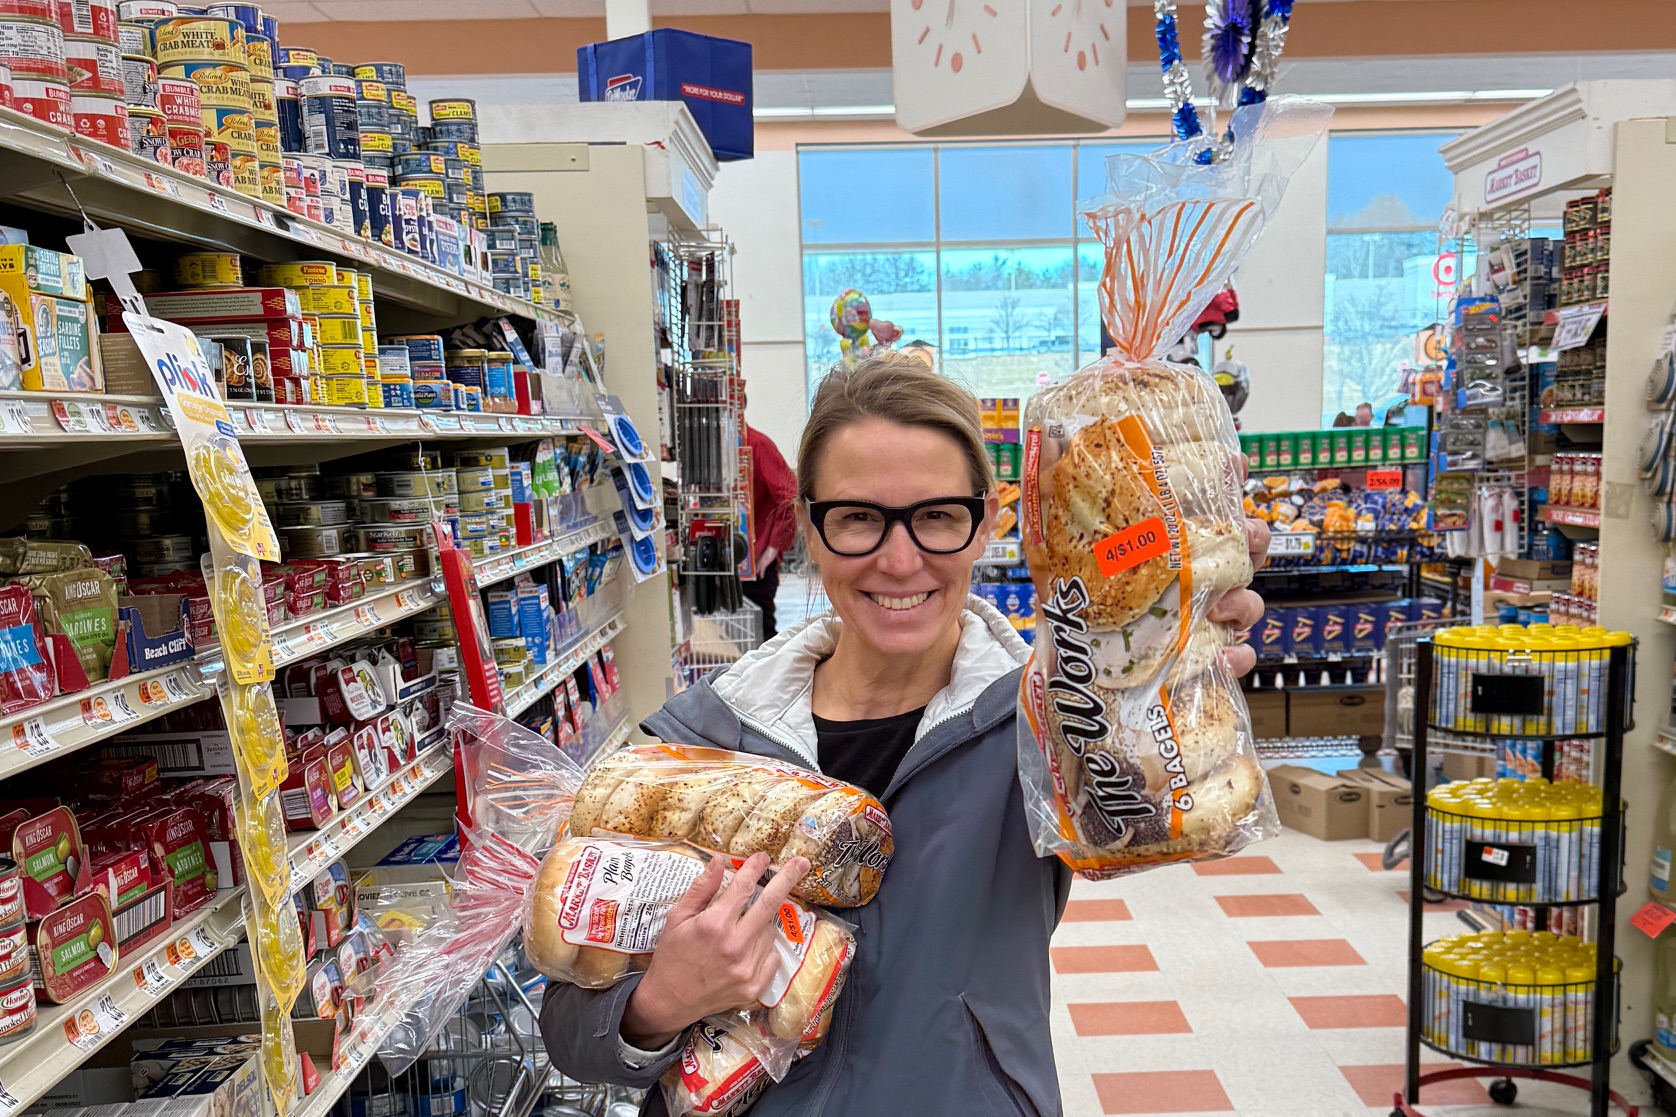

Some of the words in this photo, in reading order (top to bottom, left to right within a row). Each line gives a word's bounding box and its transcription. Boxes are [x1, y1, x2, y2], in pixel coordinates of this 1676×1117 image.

[160, 40, 180, 51] CRAB
[181, 39, 213, 51] MEAT
[181, 31, 216, 40] WHITE
[197, 71, 223, 81] Roland
[165, 85, 191, 94] BUMBLE
[200, 85, 228, 95] CRAB
[177, 134, 204, 146] GEISH
[57, 320, 82, 336] SARDINE
[58, 334, 81, 351] FILLETS
[157, 352, 218, 401] plink
[1160, 490, 1172, 501] LB
[1168, 524, 1179, 535] 20
[1105, 530, 1156, 562] 4/$1.00
[1168, 552, 1182, 570] NET
[65, 583, 77, 601] KING
[76, 580, 101, 597] OSCAR
[0, 597, 19, 615] SCAR
[145, 642, 169, 660] Beach
[169, 635, 188, 654] Cliff
[1041, 575, 1113, 757] Works
[1147, 704, 1189, 792] BAGELS
[1084, 750, 1156, 837] The
[1173, 792, 1194, 812] 6
[25, 830, 36, 842] KING
[35, 825, 52, 839] OSCAR
[32, 853, 55, 872] SALMON
[602, 856, 621, 886] Plain
[620, 851, 636, 883] Bagels
[562, 877, 587, 928] MARKET
[577, 850, 600, 883] BASKET
[53, 923, 67, 937] KING
[66, 912, 84, 930] OSCAR
[617, 913, 631, 948] Nutrition
[624, 899, 635, 916] Facts
[638, 926, 648, 950] Calories
[645, 903, 654, 916] 250
[60, 940, 86, 962] SALMON
[5, 992, 28, 1006] Hormel
